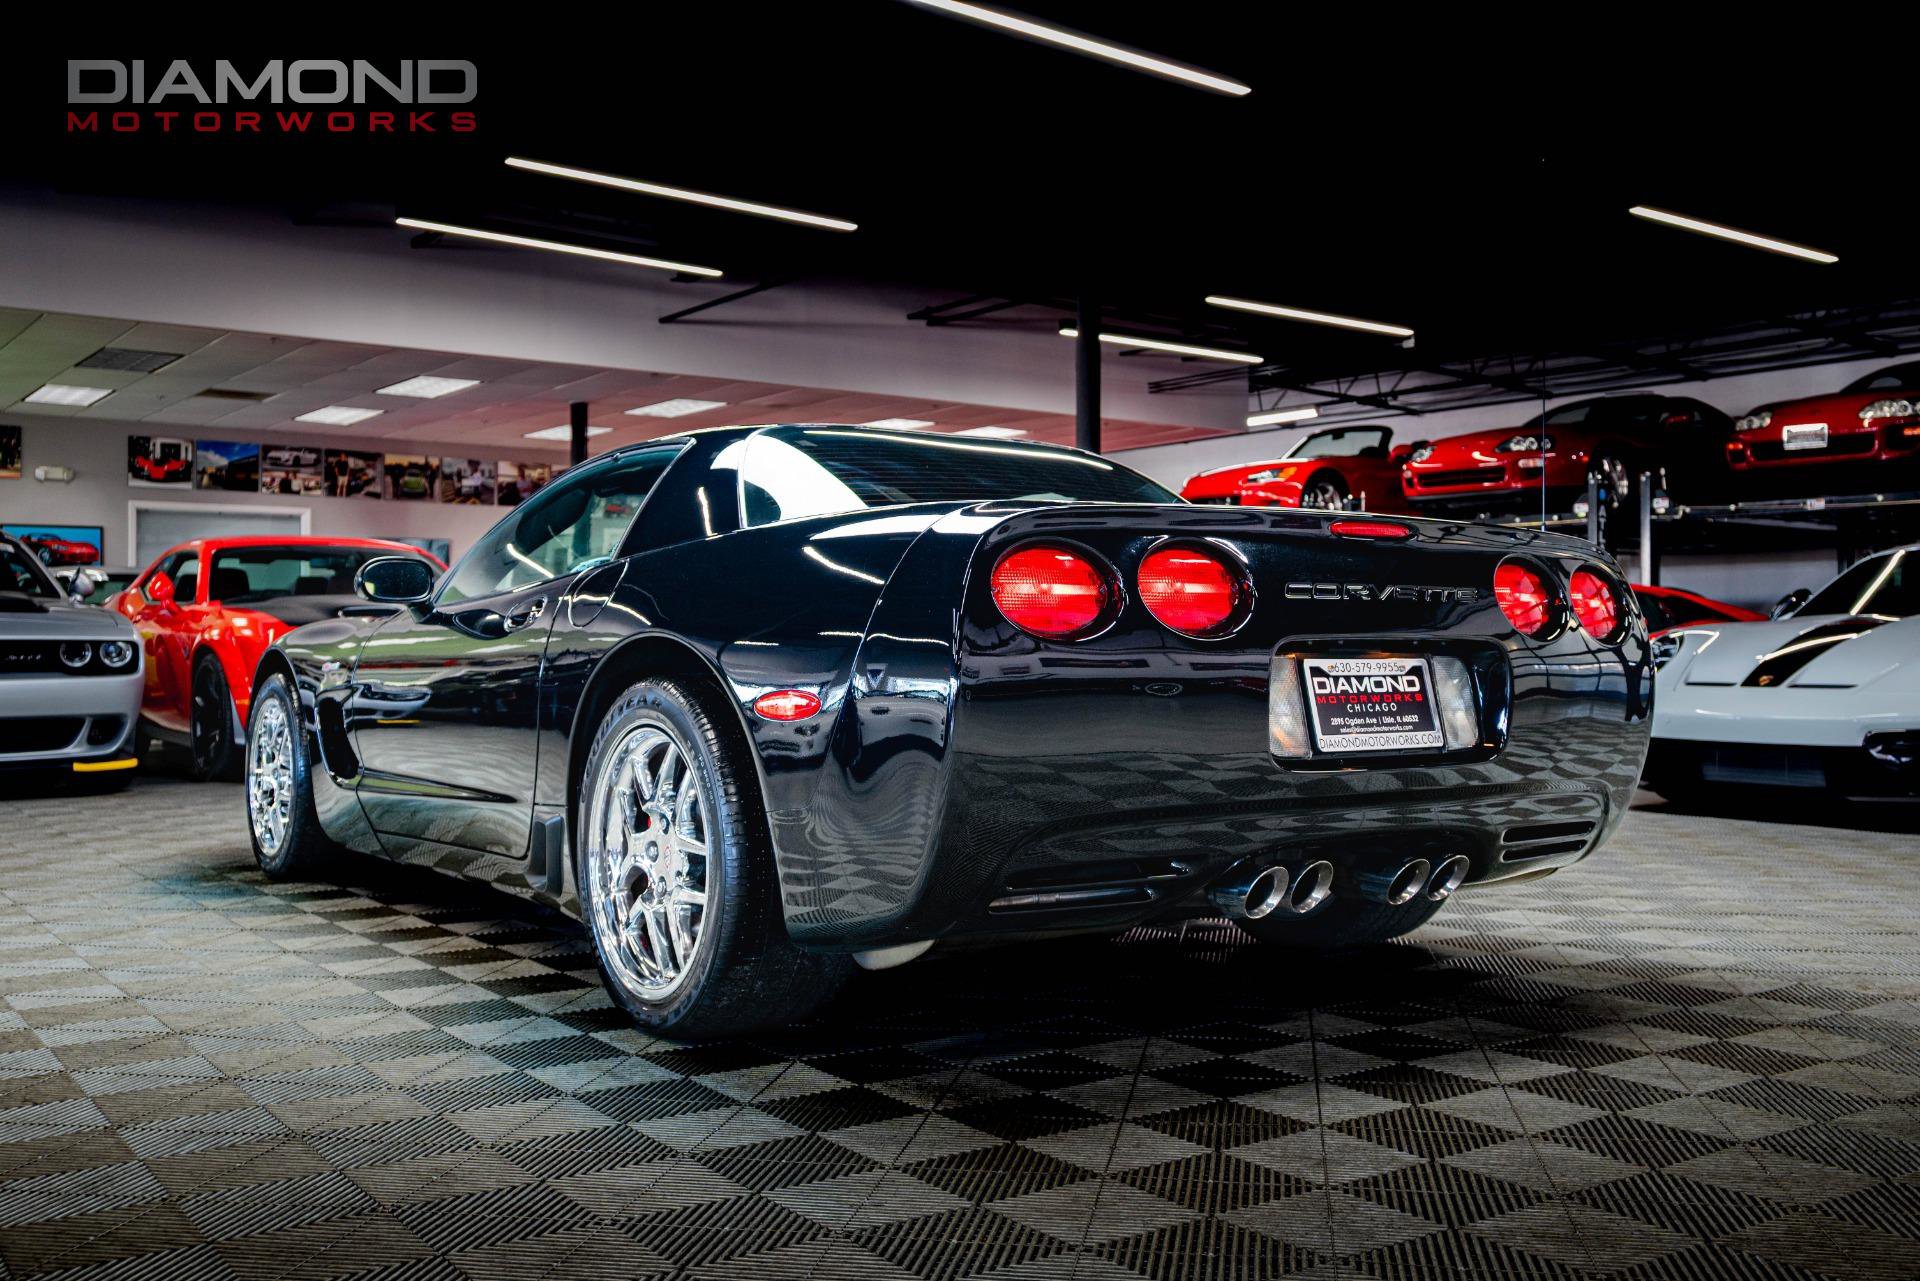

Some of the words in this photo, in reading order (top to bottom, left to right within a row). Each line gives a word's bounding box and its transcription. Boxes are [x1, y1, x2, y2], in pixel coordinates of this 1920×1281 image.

[1285, 583, 1478, 602] CORVETTE
[1334, 662, 1399, 673] 630-579-9955
[1312, 676, 1420, 693] DIAMOND
[1316, 693, 1423, 704] MOTORWORKS
[1348, 703, 1397, 712] CHICAGO
[1345, 717, 1365, 726] Ogden
[1366, 716, 1377, 724] Ave
[1320, 733, 1443, 748] DIAMONDMOTORWORKS.COM
